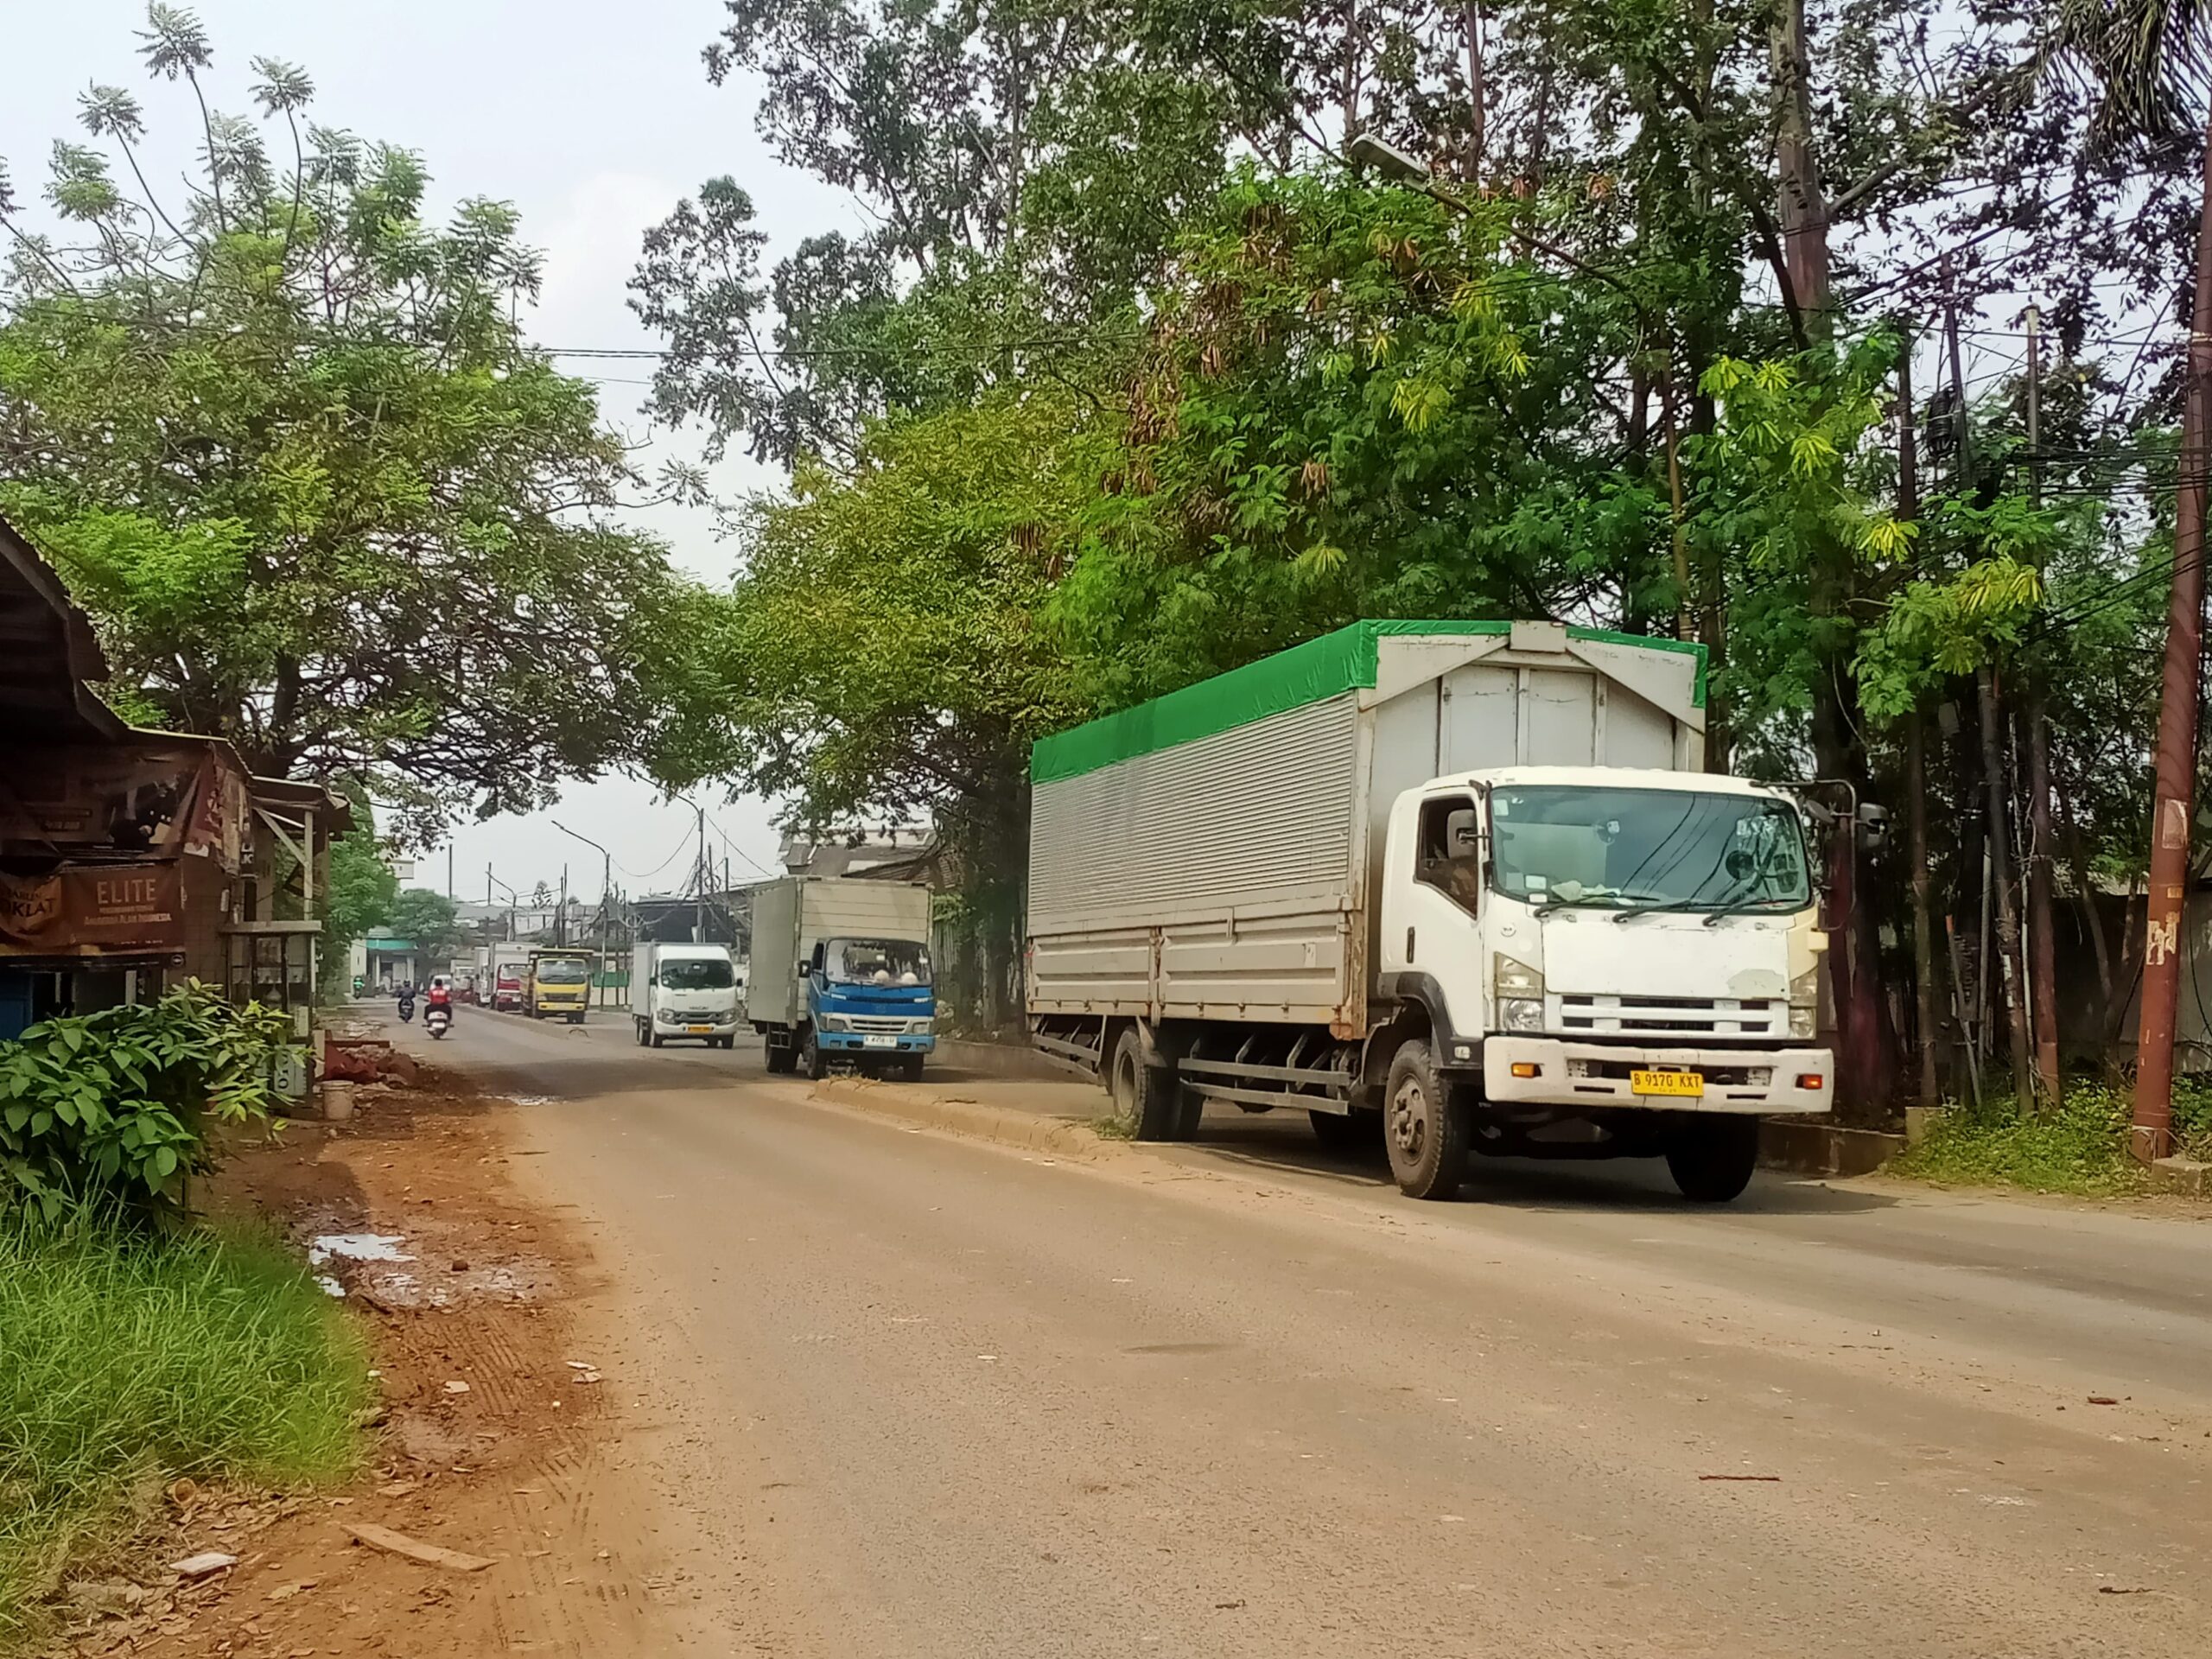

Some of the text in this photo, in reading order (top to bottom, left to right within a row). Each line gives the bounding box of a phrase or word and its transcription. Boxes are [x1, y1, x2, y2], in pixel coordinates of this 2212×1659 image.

[97, 878, 157, 905] ELITE
[1634, 1073, 1641, 1085] B
[1680, 1074, 1700, 1088] KXT
